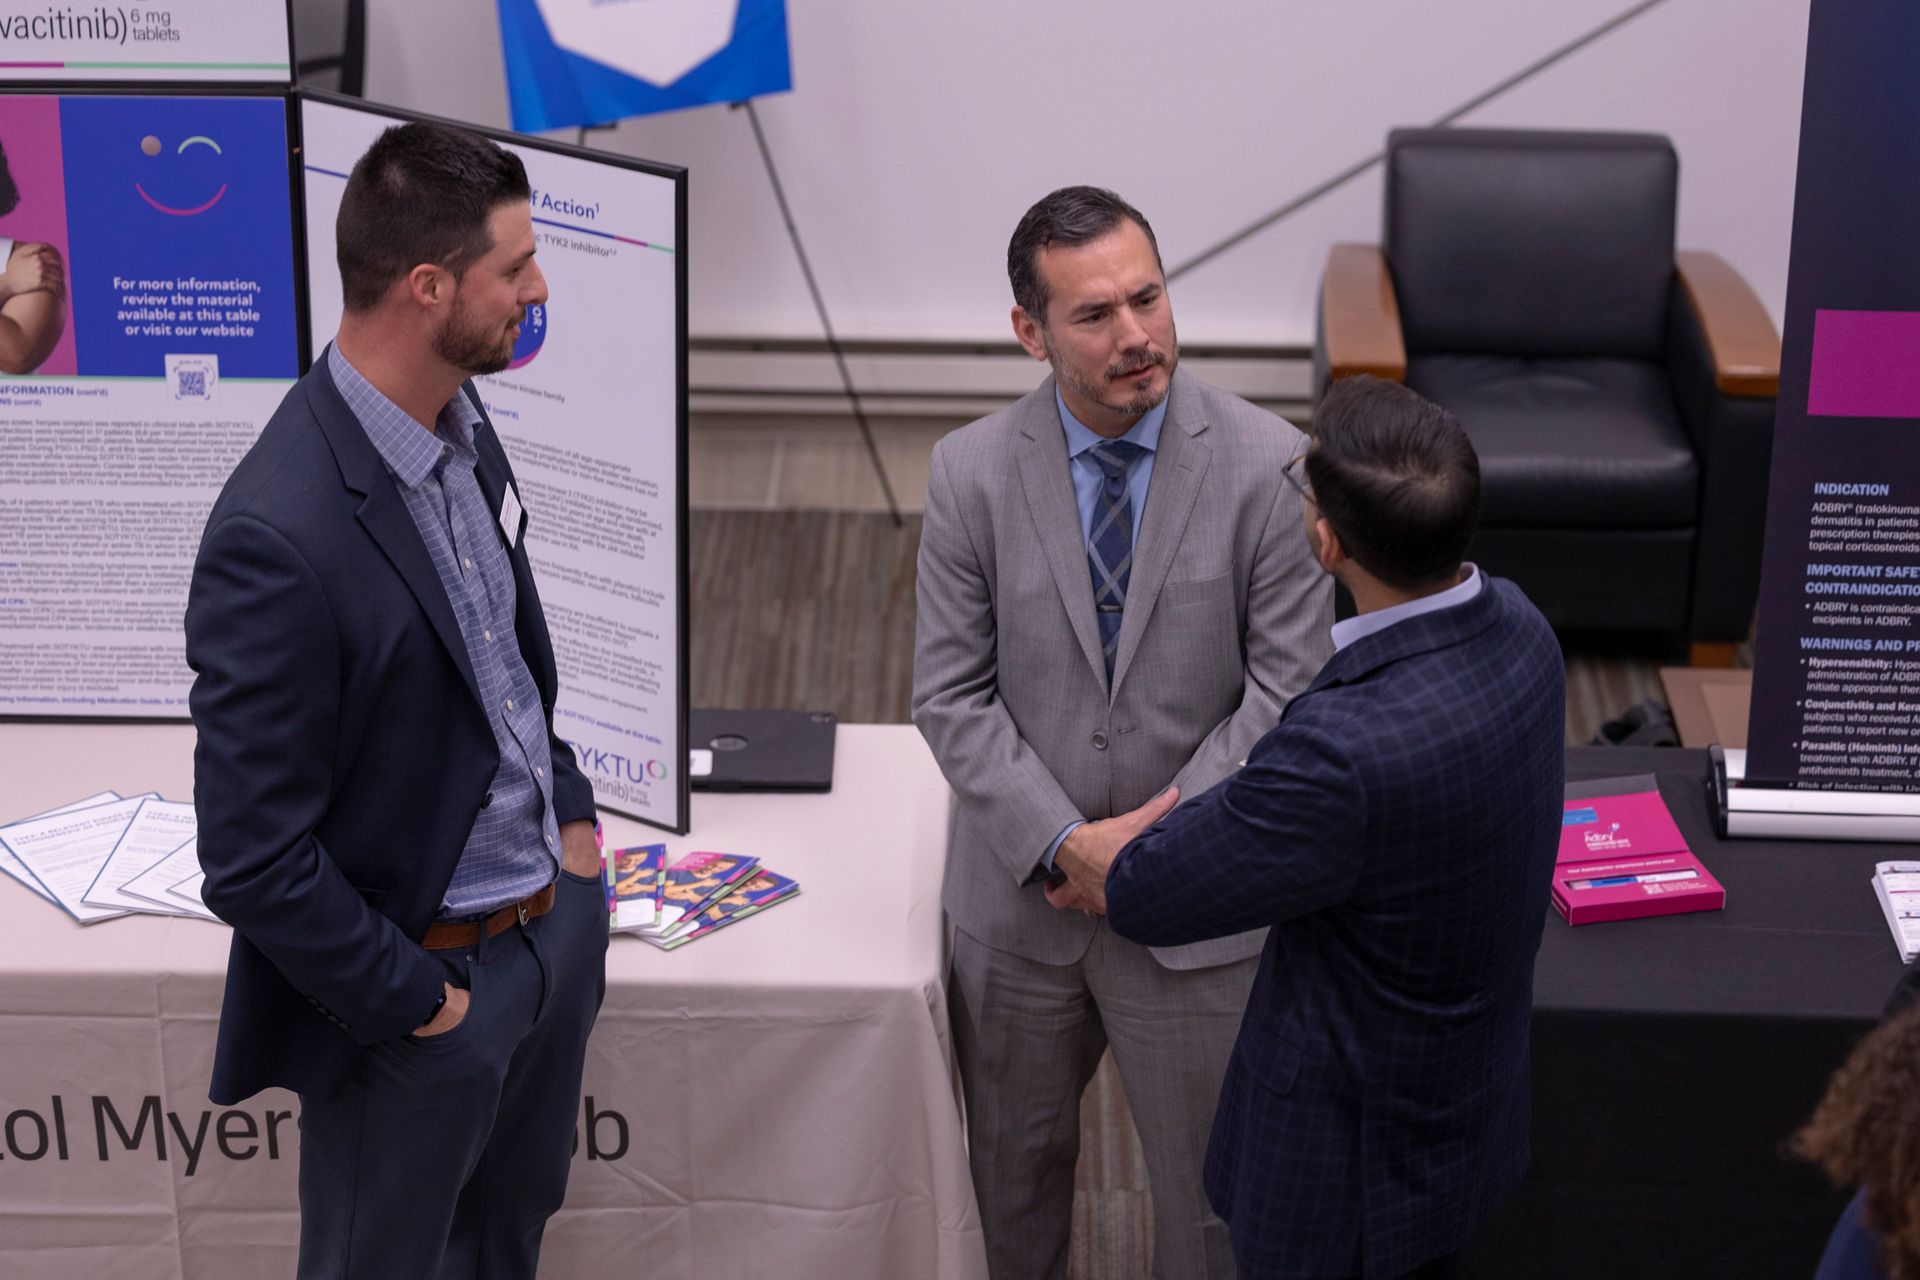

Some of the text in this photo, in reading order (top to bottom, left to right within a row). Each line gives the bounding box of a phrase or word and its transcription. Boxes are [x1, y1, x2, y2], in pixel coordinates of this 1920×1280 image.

[130, 8, 170, 26] 6 mg
[133, 26, 180, 41] tablets
[544, 234, 568, 248] TYK2
[114, 276, 261, 294] For more information,
[122, 293, 253, 306] review the material
[117, 308, 260, 322] available at this table
[125, 323, 254, 337] or visit our website
[1814, 482, 1890, 496] INDICATION
[1811, 516, 1918, 528] dermatitis in patients
[1810, 529, 1920, 542] prescription therapies
[1808, 541, 1843, 552] topical
[1806, 564, 1884, 577] IMPORTANT
[1814, 602, 1848, 612] ADBRY
[1850, 604, 1860, 612] is
[1812, 615, 1912, 626] excipients in ADBRY.
[1800, 637, 1872, 650] WARNINGS
[1874, 640, 1904, 652] AND
[1809, 657, 1892, 670] Hypersensitivity:
[1808, 670, 1878, 681] administration
[1880, 672, 1890, 681] of
[1806, 682, 1840, 692] initiate
[1842, 682, 1898, 694] appropriate
[1805, 698, 1874, 710] Conjunctivitis
[1876, 701, 1896, 711] and
[1804, 712, 1845, 724] subjects
[1848, 713, 1868, 722] who
[1870, 714, 1910, 724] received
[1802, 724, 1842, 735] patients
[1844, 725, 1855, 734] to
[1856, 726, 1886, 737] report
[1888, 728, 1909, 736] new
[1801, 740, 1846, 752] Parasitic
[1848, 742, 1902, 754] (Helminth)
[1800, 754, 1848, 763] treatment
[1850, 754, 1870, 764] with
[1872, 756, 1908, 766] ADBRY.
[1798, 766, 1860, 776] antihelminth
[91, 1095, 301, 1177] Myer
